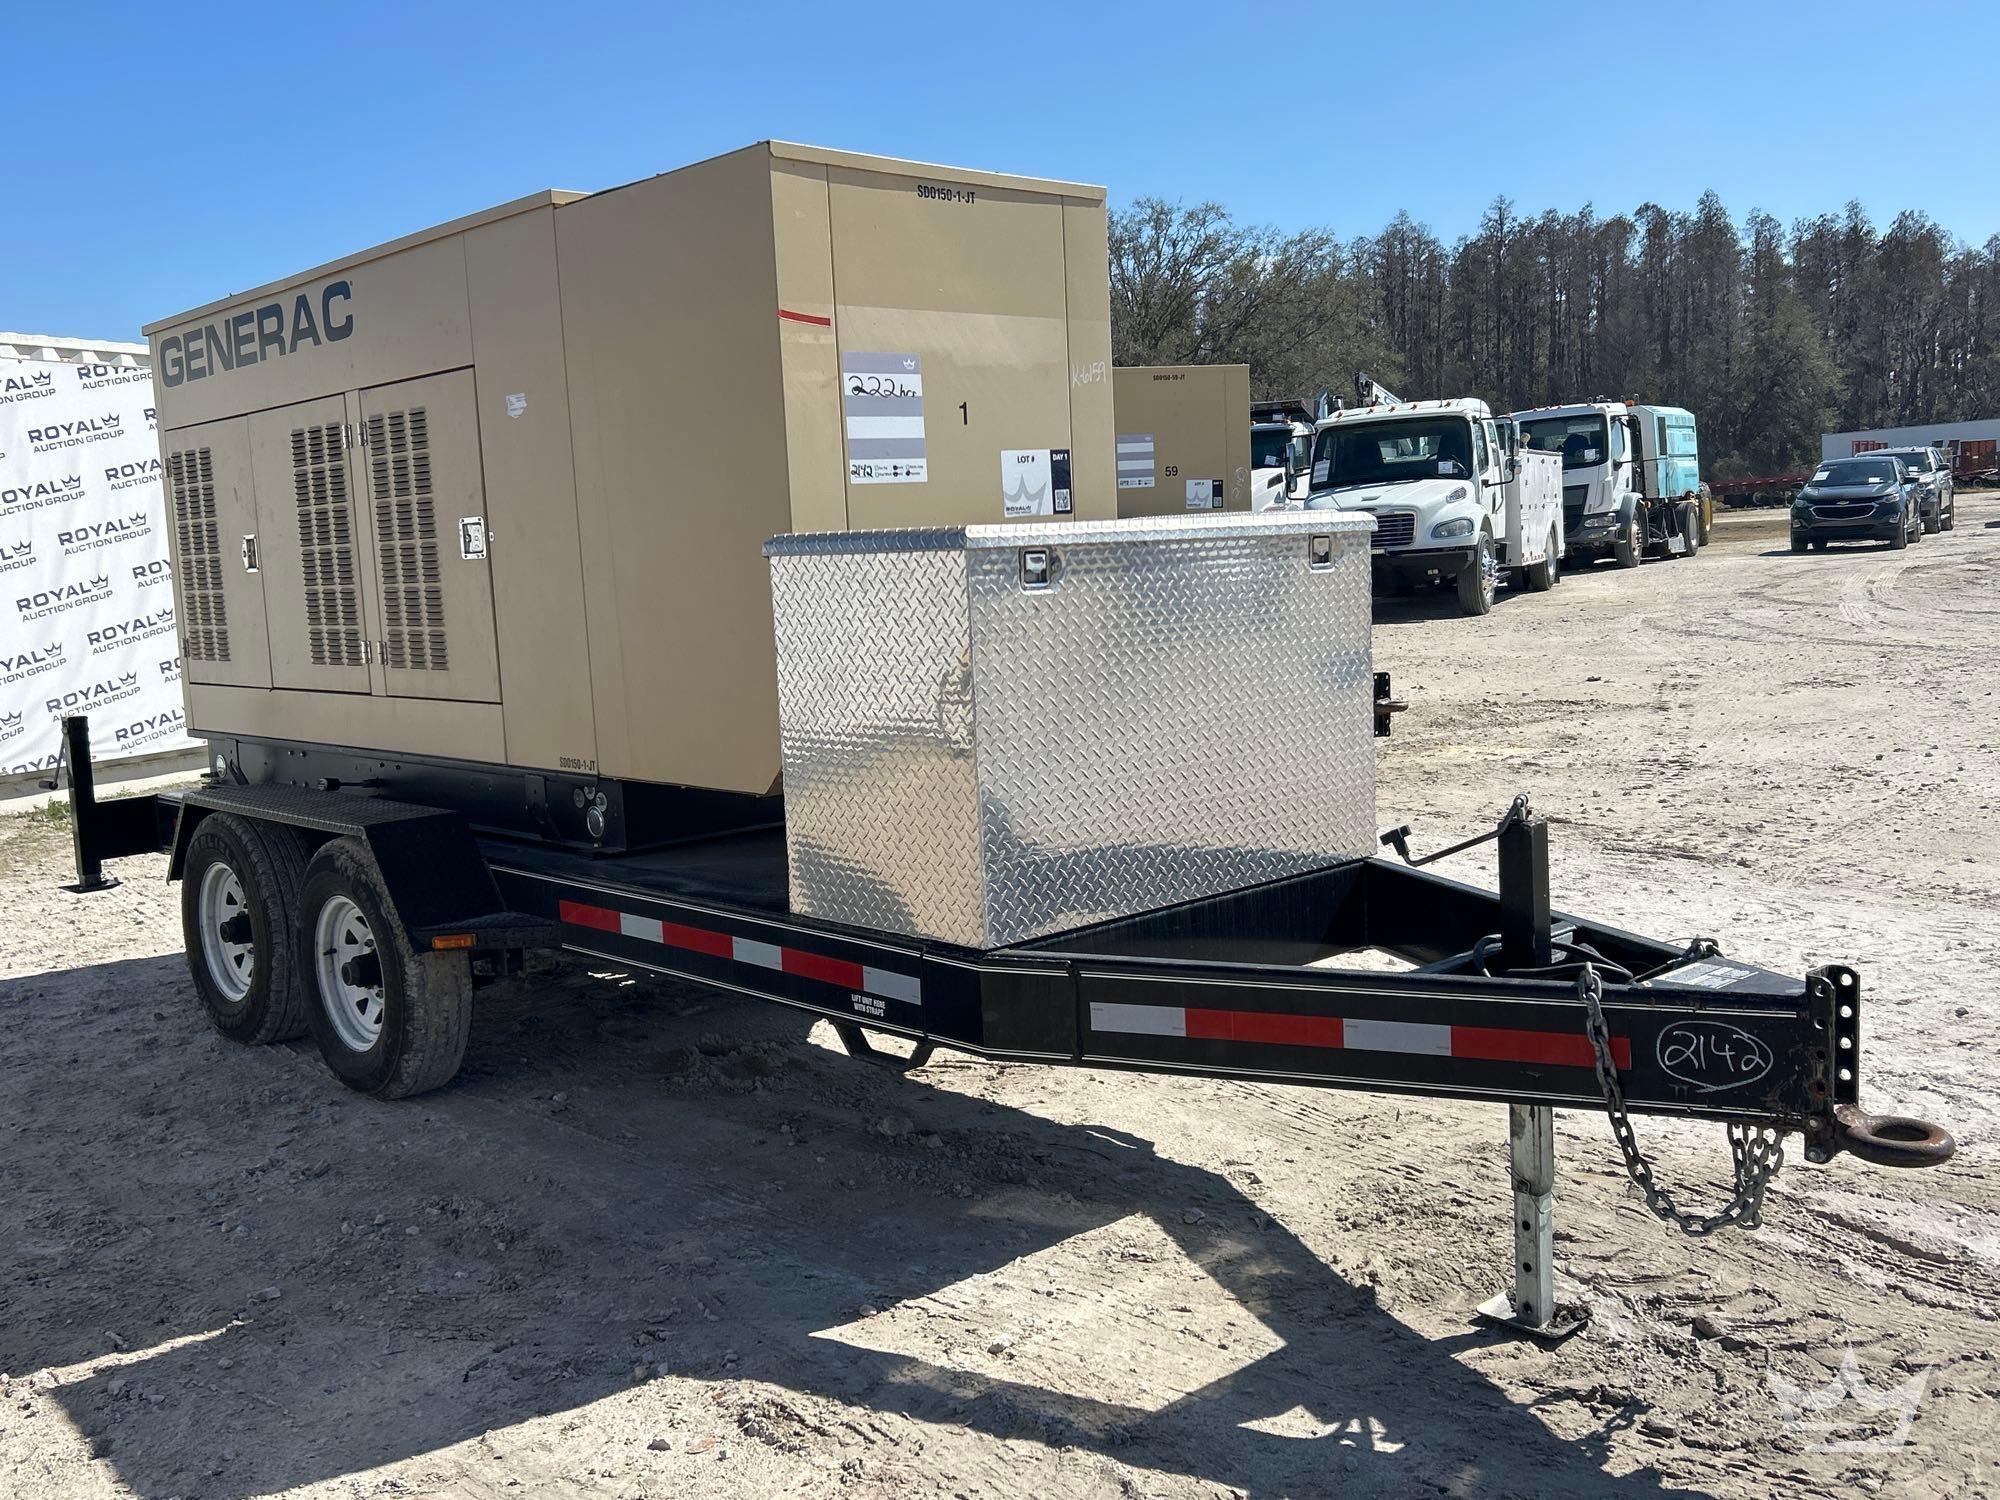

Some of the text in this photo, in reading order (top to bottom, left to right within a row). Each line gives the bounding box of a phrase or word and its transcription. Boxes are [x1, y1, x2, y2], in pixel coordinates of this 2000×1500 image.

[159, 280, 353, 388] GENERAC
[16, 388, 56, 401] GROUP
[82, 376, 131, 390] AUCTION
[958, 401, 968, 425] 1
[28, 418, 103, 443] ROYAL
[33, 429, 124, 454] AUCTION GROUP
[110, 474, 157, 491] AUCTION
[1165, 466, 1178, 477] 59
[45, 490, 85, 506] GROUP
[57, 518, 131, 546] ROYAL
[64, 527, 151, 556] AUCTION GROUP
[16, 582, 92, 613] ROYAL
[22, 590, 113, 623] AUCTION GROUP
[87, 615, 157, 645] ROYAL
[92, 634, 141, 655] AUCTION
[26, 657, 67, 677] GROUP
[46, 679, 121, 713] ROYAL
[103, 686, 141, 705] GROUP
[115, 709, 184, 742] ROYAL
[120, 729, 168, 752] AUCTION
[851, 993, 886, 1009] LIFT UNIT HERE
[854, 1003, 884, 1017] WITH STRAPS
[1664, 1030, 1766, 1073] 2142
